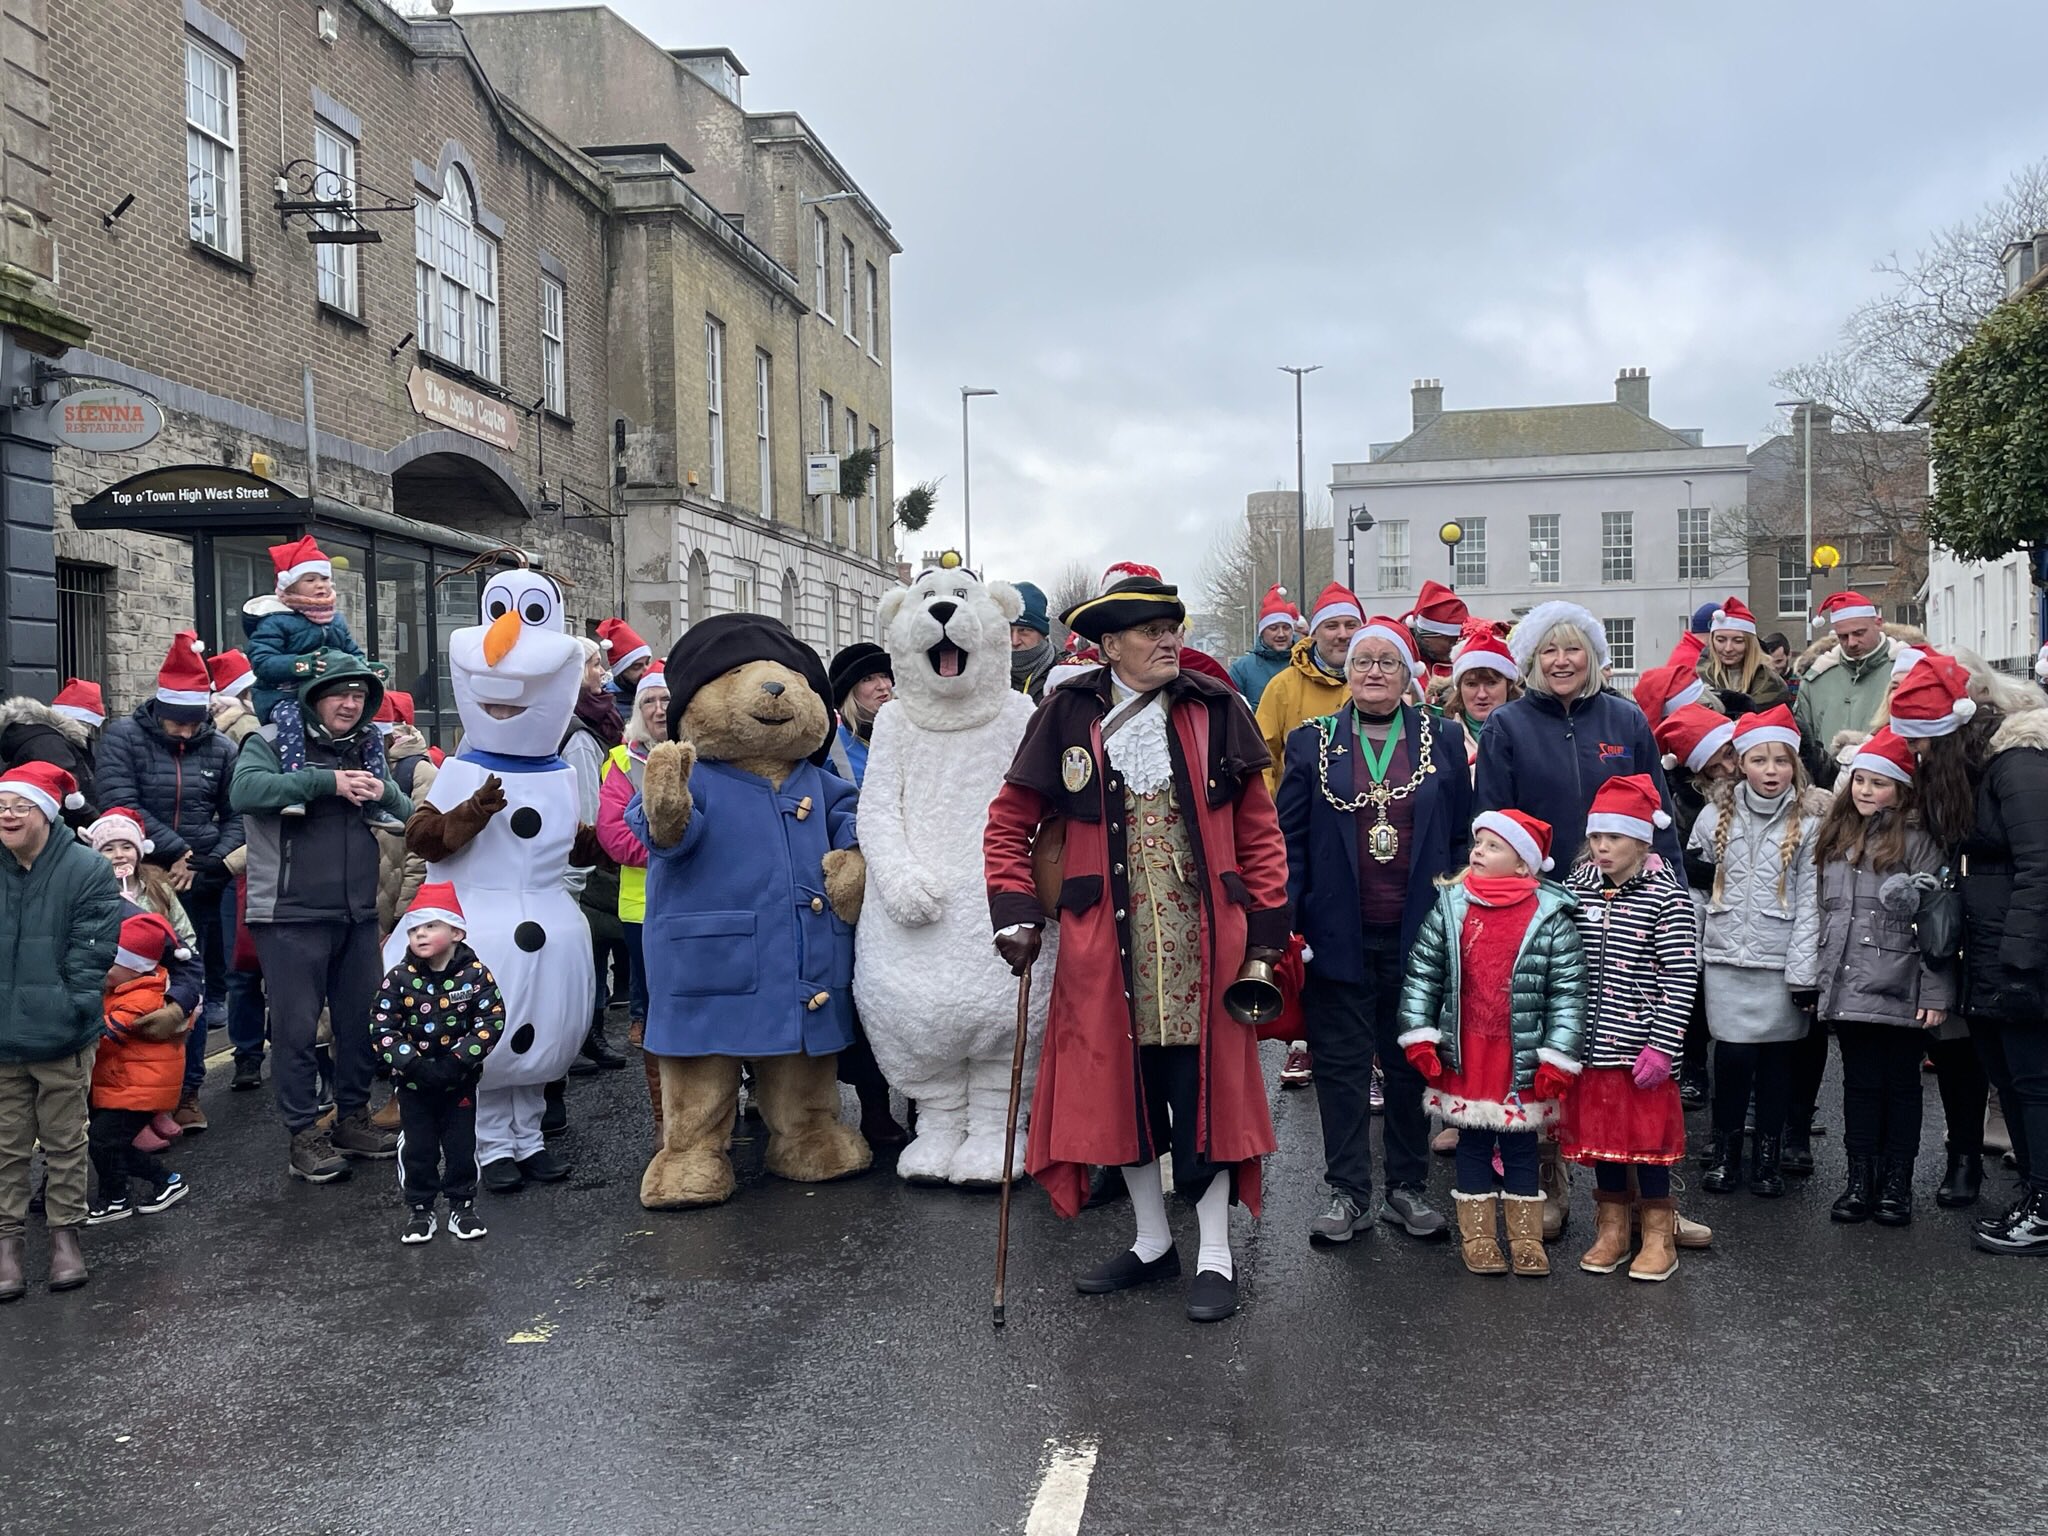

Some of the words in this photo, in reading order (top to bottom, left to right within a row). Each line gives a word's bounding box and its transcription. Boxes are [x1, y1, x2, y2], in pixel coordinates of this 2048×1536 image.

[425, 376, 446, 409] The
[449, 386, 474, 419] Spice
[478, 399, 506, 433] Centre
[64, 406, 145, 421] SIENNA
[65, 423, 145, 433] RESTAURANT
[112, 491, 132, 506] Top
[178, 488, 202, 503] High
[205, 487, 233, 500] West
[236, 486, 269, 499] Street
